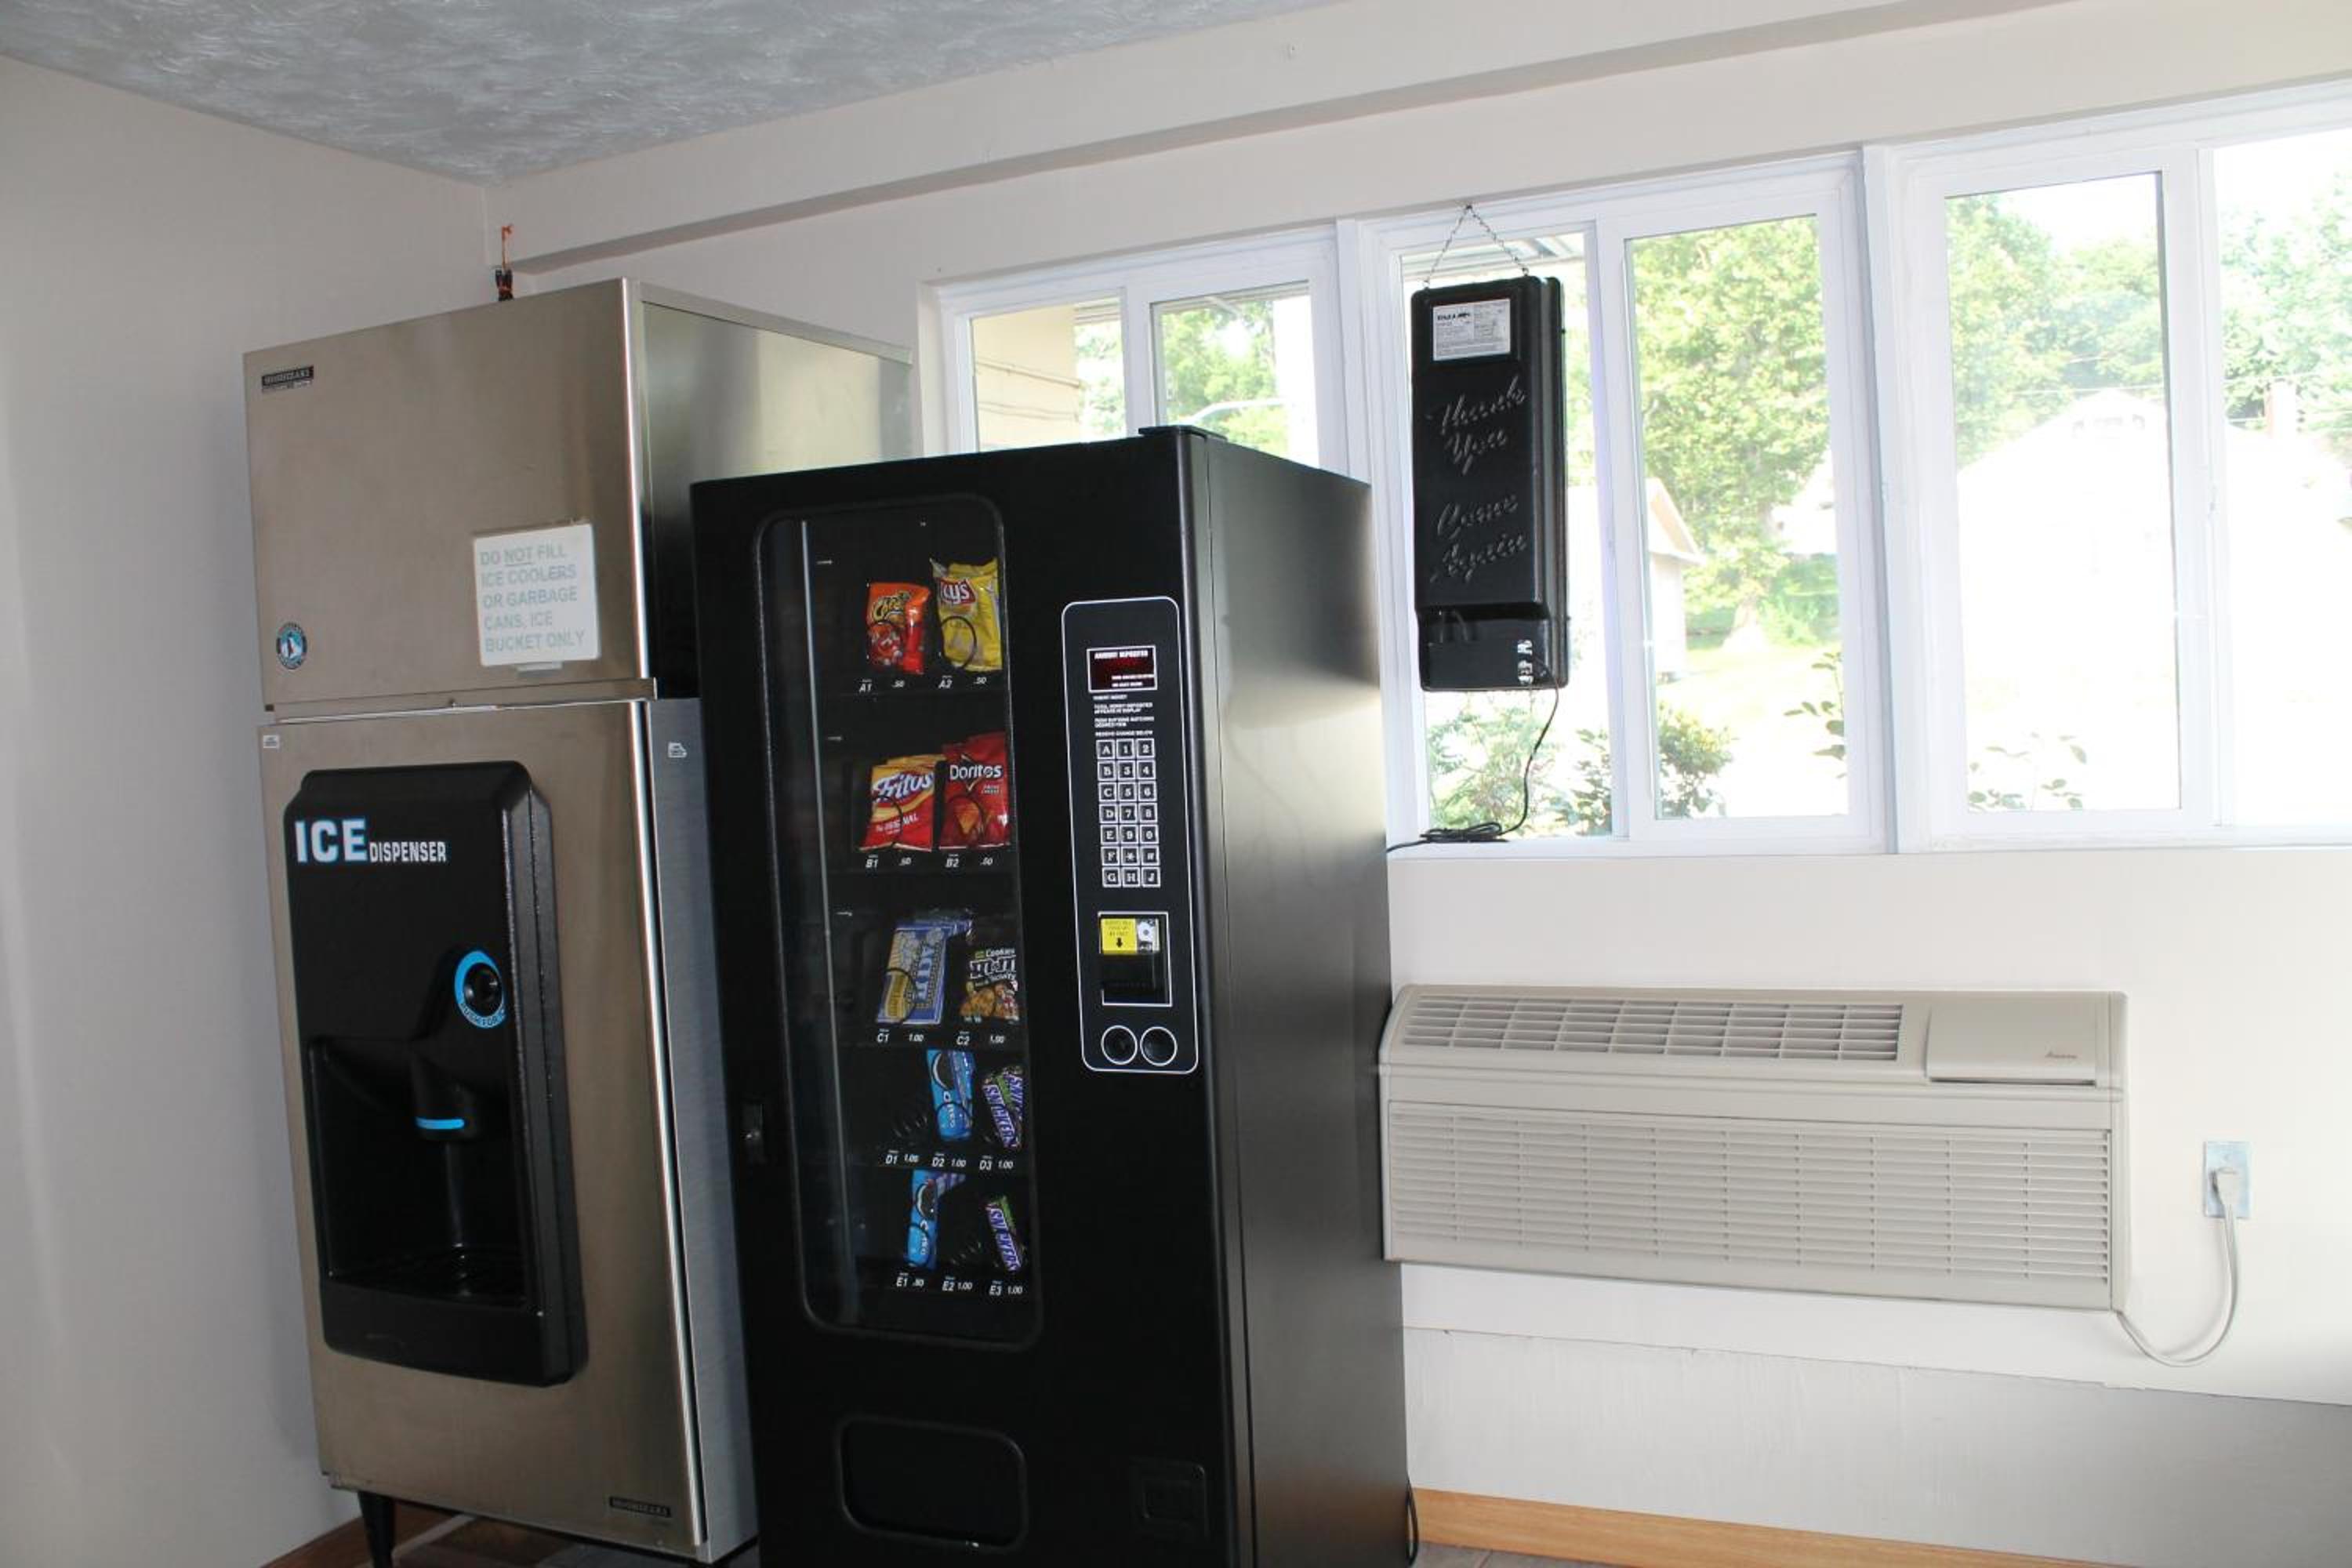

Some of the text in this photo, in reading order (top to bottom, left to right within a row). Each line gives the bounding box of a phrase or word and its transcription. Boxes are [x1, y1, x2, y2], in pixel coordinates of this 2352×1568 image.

[480, 543, 567, 565] DO NOT FILL
[481, 564, 577, 587] ICE COOLERS
[483, 586, 579, 609] OR GARBAGE
[531, 610, 554, 626] ICE
[485, 628, 585, 652] BUCKET ONLY
[858, 683, 873, 692] A1
[938, 680, 953, 689] A2
[1102, 746, 1110, 754] A
[949, 764, 1003, 780] Doritos
[1104, 767, 1112, 775] B
[1142, 766, 1149, 775] 4
[871, 771, 935, 799] Fritos
[1104, 788, 1112, 797] C
[1105, 809, 1114, 818] D
[1125, 810, 1131, 818] 7
[294, 818, 446, 863] ICE DISPENSER
[1108, 852, 1116, 861] F
[865, 858, 879, 868] B1
[946, 858, 960, 868] B2
[1108, 873, 1155, 882] G H J
[877, 1033, 889, 1044] C1
[956, 1036, 971, 1046] C2
[885, 1155, 898, 1164] D1
[931, 1158, 967, 1167] D2 1.00
[979, 1160, 1014, 1171] D3 1.00
[896, 1278, 908, 1287] E1
[942, 1282, 973, 1291] E2 1.00
[989, 1287, 1003, 1296] E3
